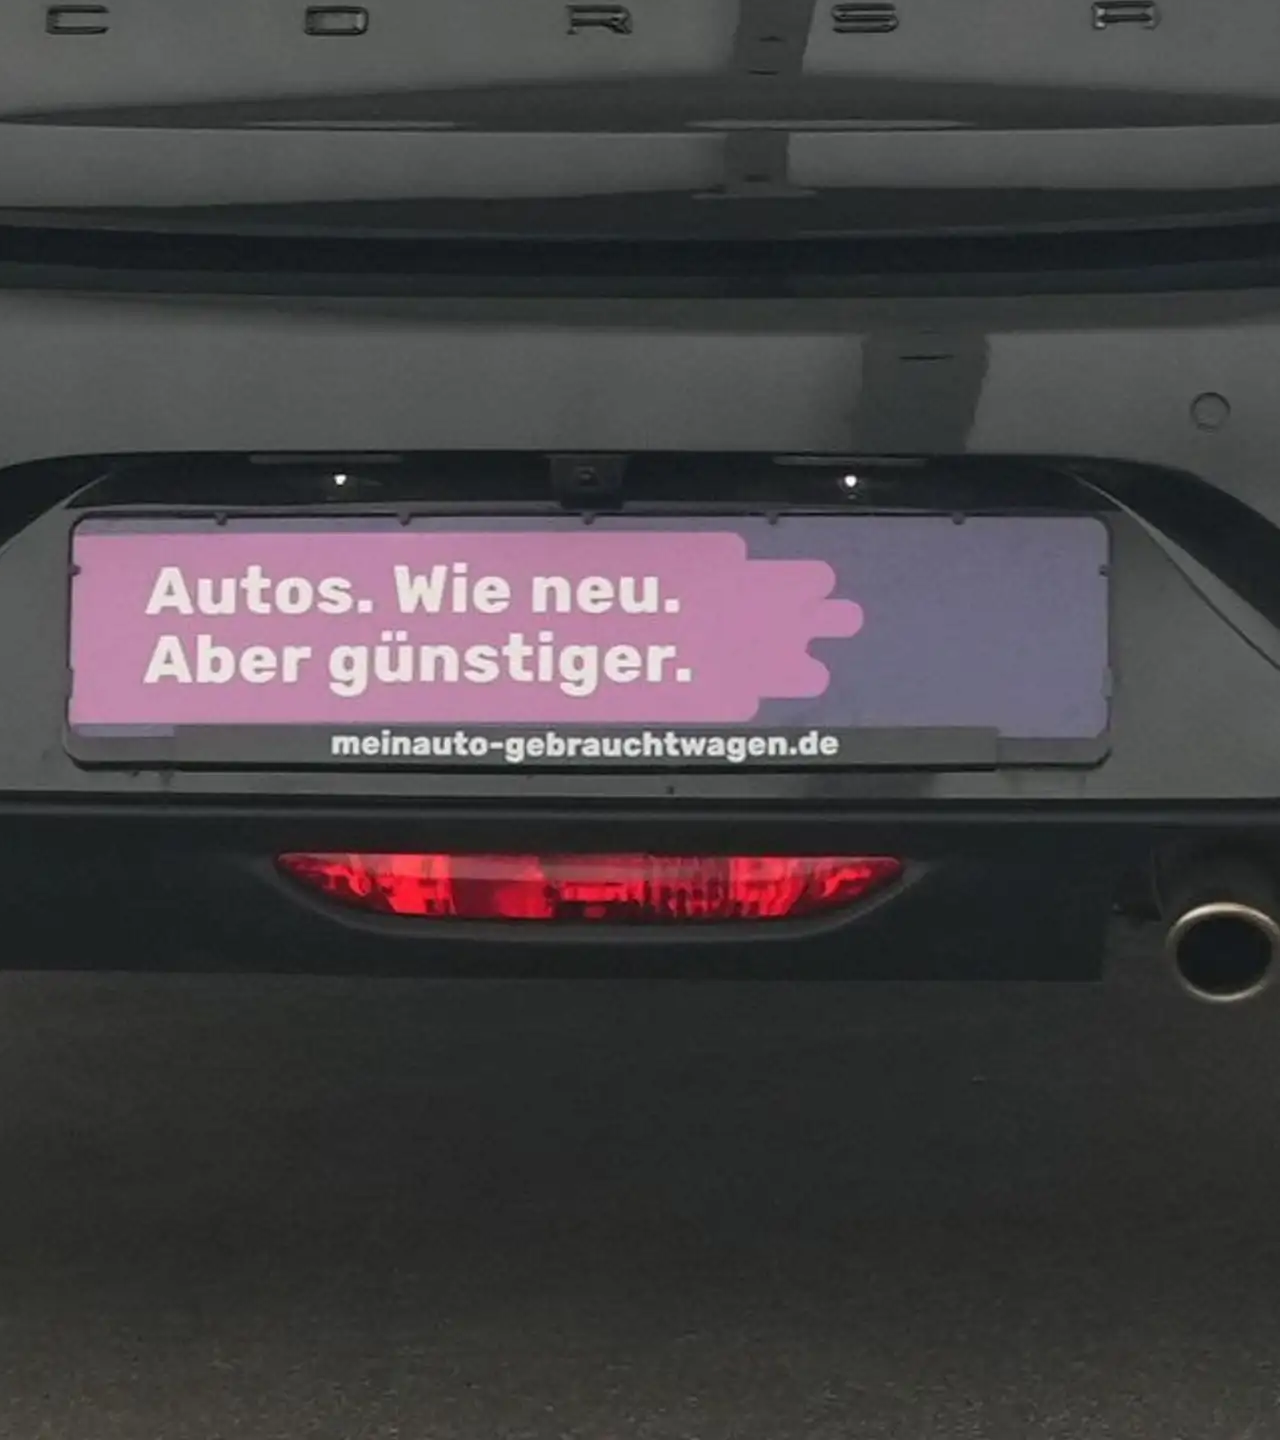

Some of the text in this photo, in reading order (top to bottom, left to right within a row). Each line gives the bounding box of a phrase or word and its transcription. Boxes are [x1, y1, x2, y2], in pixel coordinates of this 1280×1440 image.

[45, 0, 1162, 36] CORSA
[144, 561, 681, 616] Autos. Wie neu.
[143, 629, 692, 698] Aber günstiger.
[331, 729, 839, 764] meinauto-gebrauchtwagen.de
